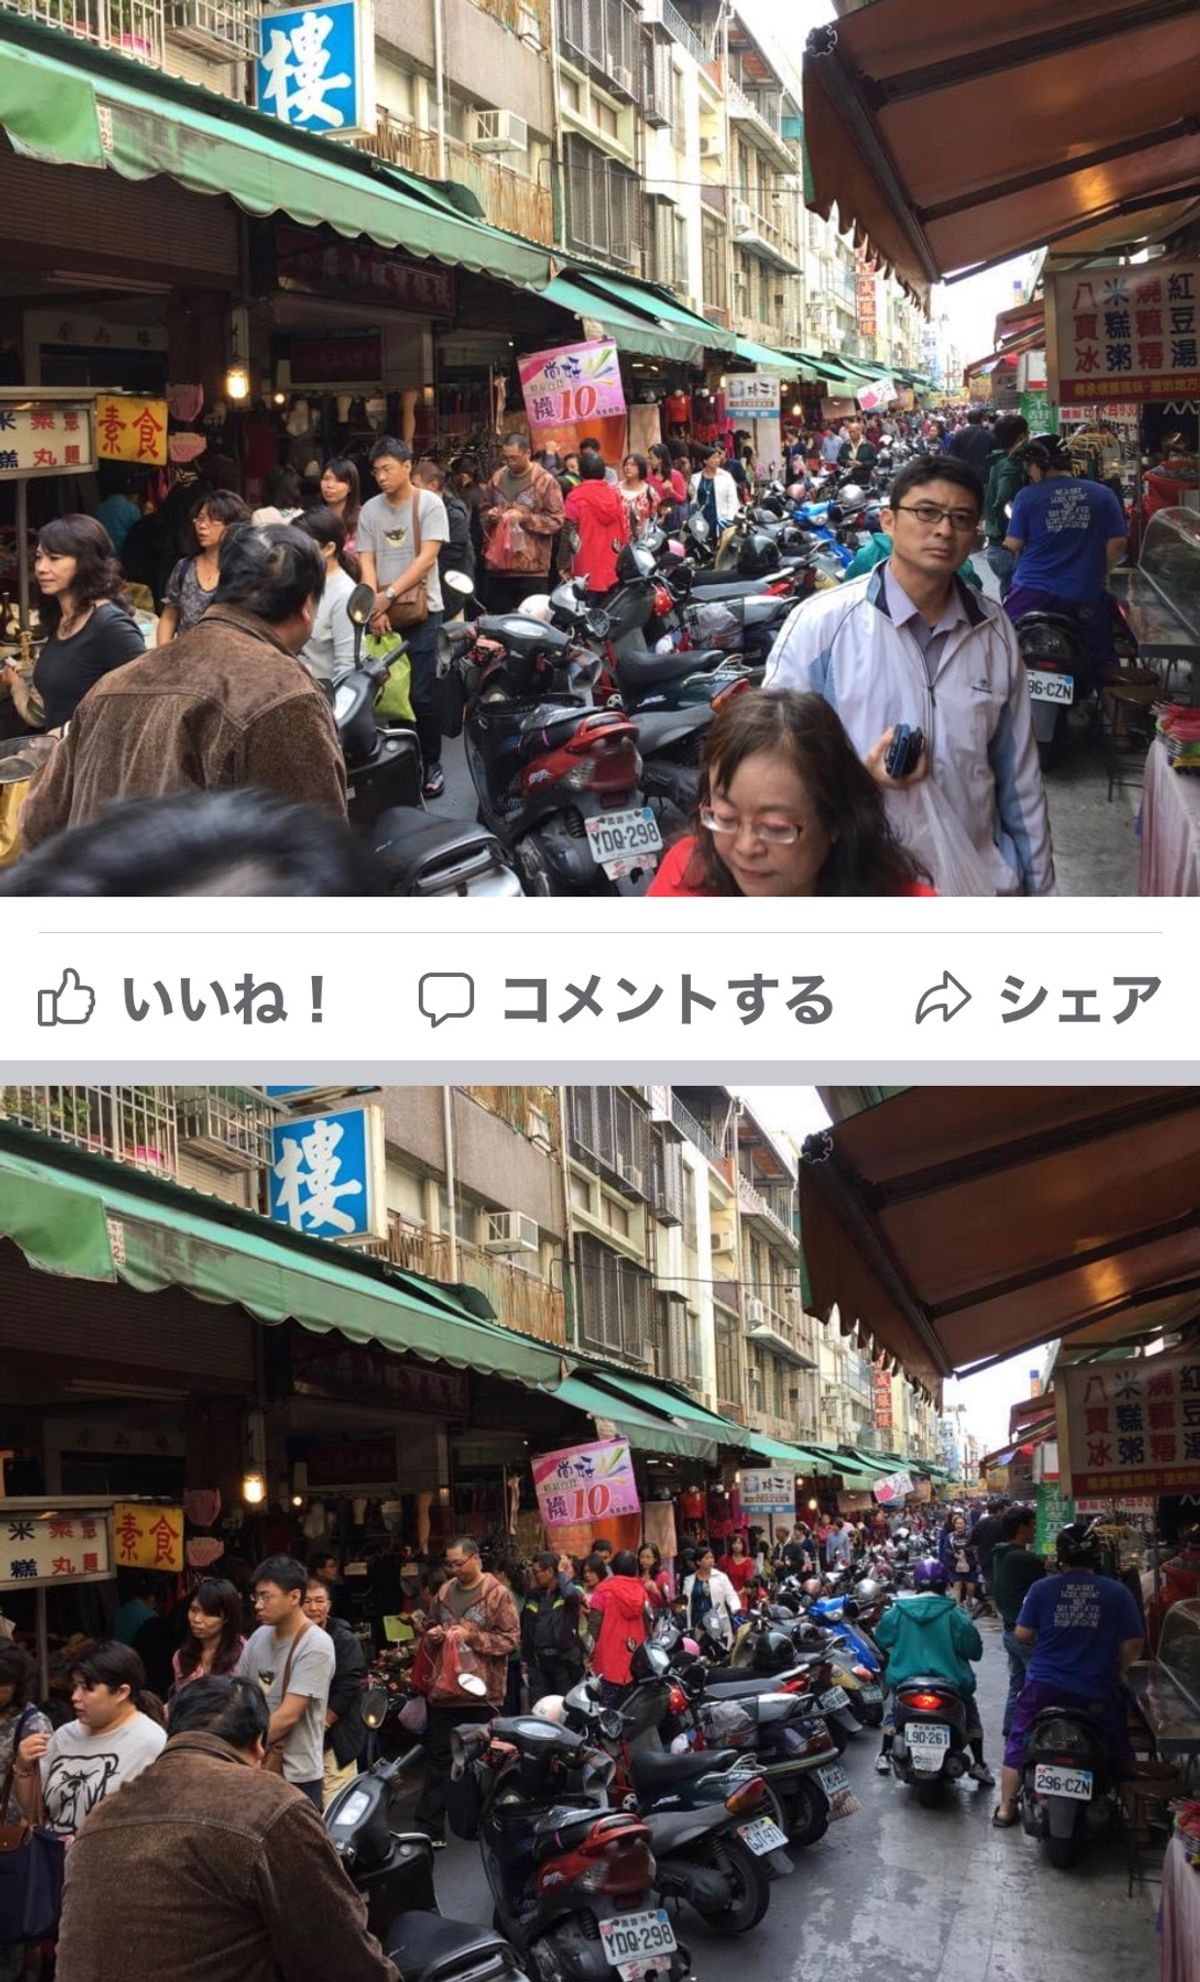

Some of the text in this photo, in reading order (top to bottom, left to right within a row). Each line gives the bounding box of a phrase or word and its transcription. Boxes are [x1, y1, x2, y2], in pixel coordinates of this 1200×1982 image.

[261, 11, 352, 127] 樓
[1072, 281, 1101, 373] 八寶冰
[1103, 277, 1132, 372] 米糕粥
[1167, 272, 1198, 369] 紅豆湯
[560, 385, 597, 419] 10
[98, 405, 163, 458] 素食
[591, 822, 659, 855] YDQ-298
[273, 1119, 363, 1233] 樓
[1084, 1375, 1113, 1467] 八寶冰
[1114, 1370, 1145, 1465] 米糕粥
[572, 1484, 610, 1519] 10
[8, 1521, 38, 1578] 米糕
[116, 1513, 179, 1565] 素食
[906, 1730, 948, 1745] L9D-261
[1037, 1774, 1090, 1795] 296-CZN
[605, 1923, 674, 1957] YDQ-298
